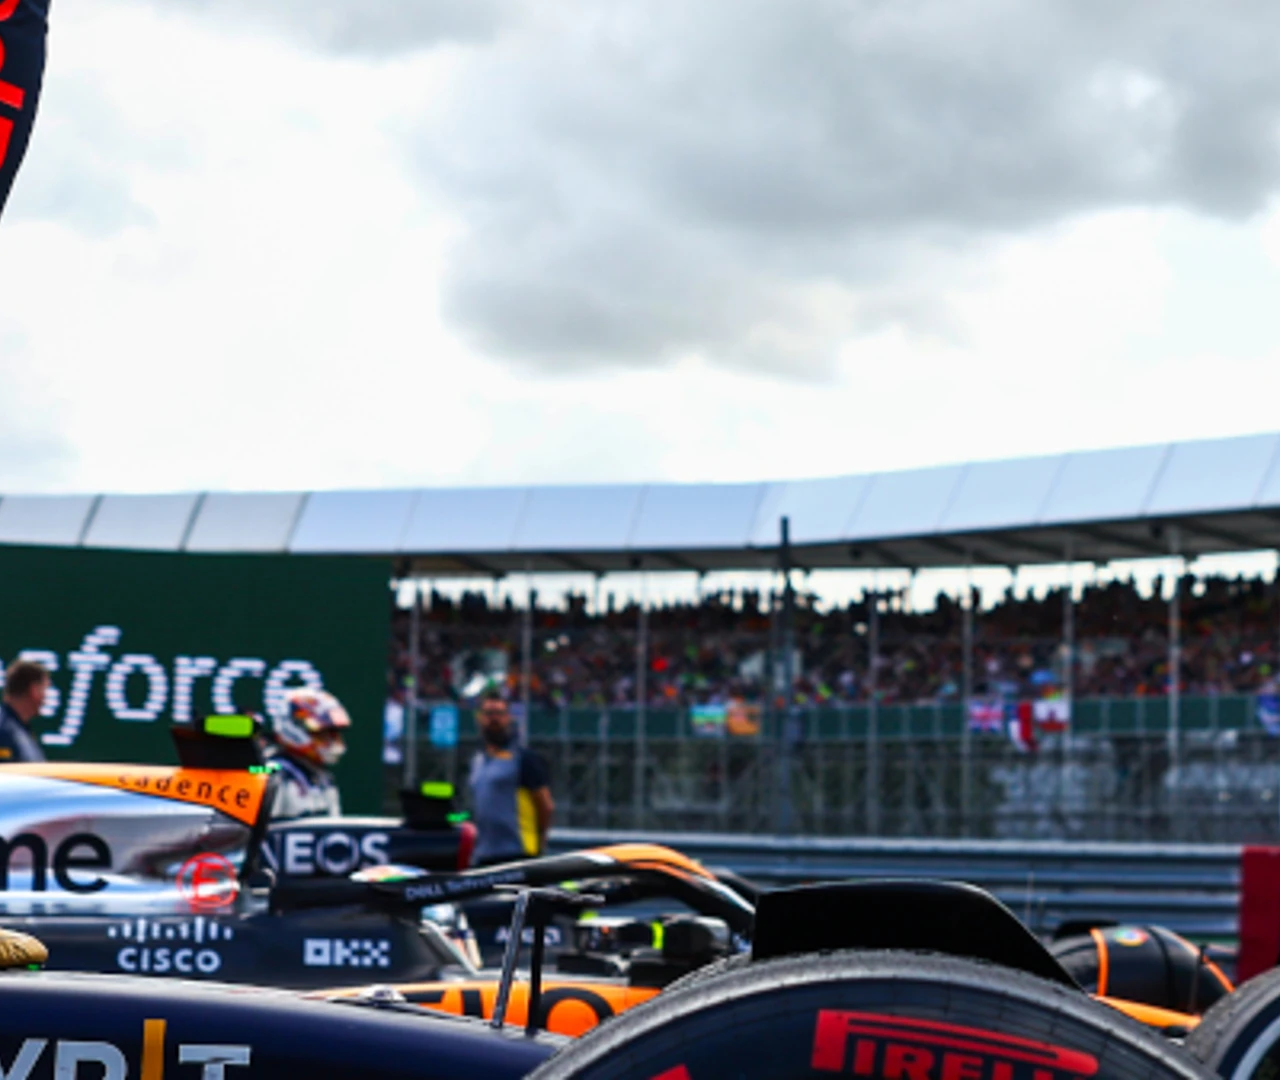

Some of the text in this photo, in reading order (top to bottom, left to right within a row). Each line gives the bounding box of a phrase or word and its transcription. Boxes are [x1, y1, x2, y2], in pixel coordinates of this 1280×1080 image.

[118, 774, 251, 808] cadence
[260, 832, 390, 874] NEOS
[303, 938, 391, 967] OKX
